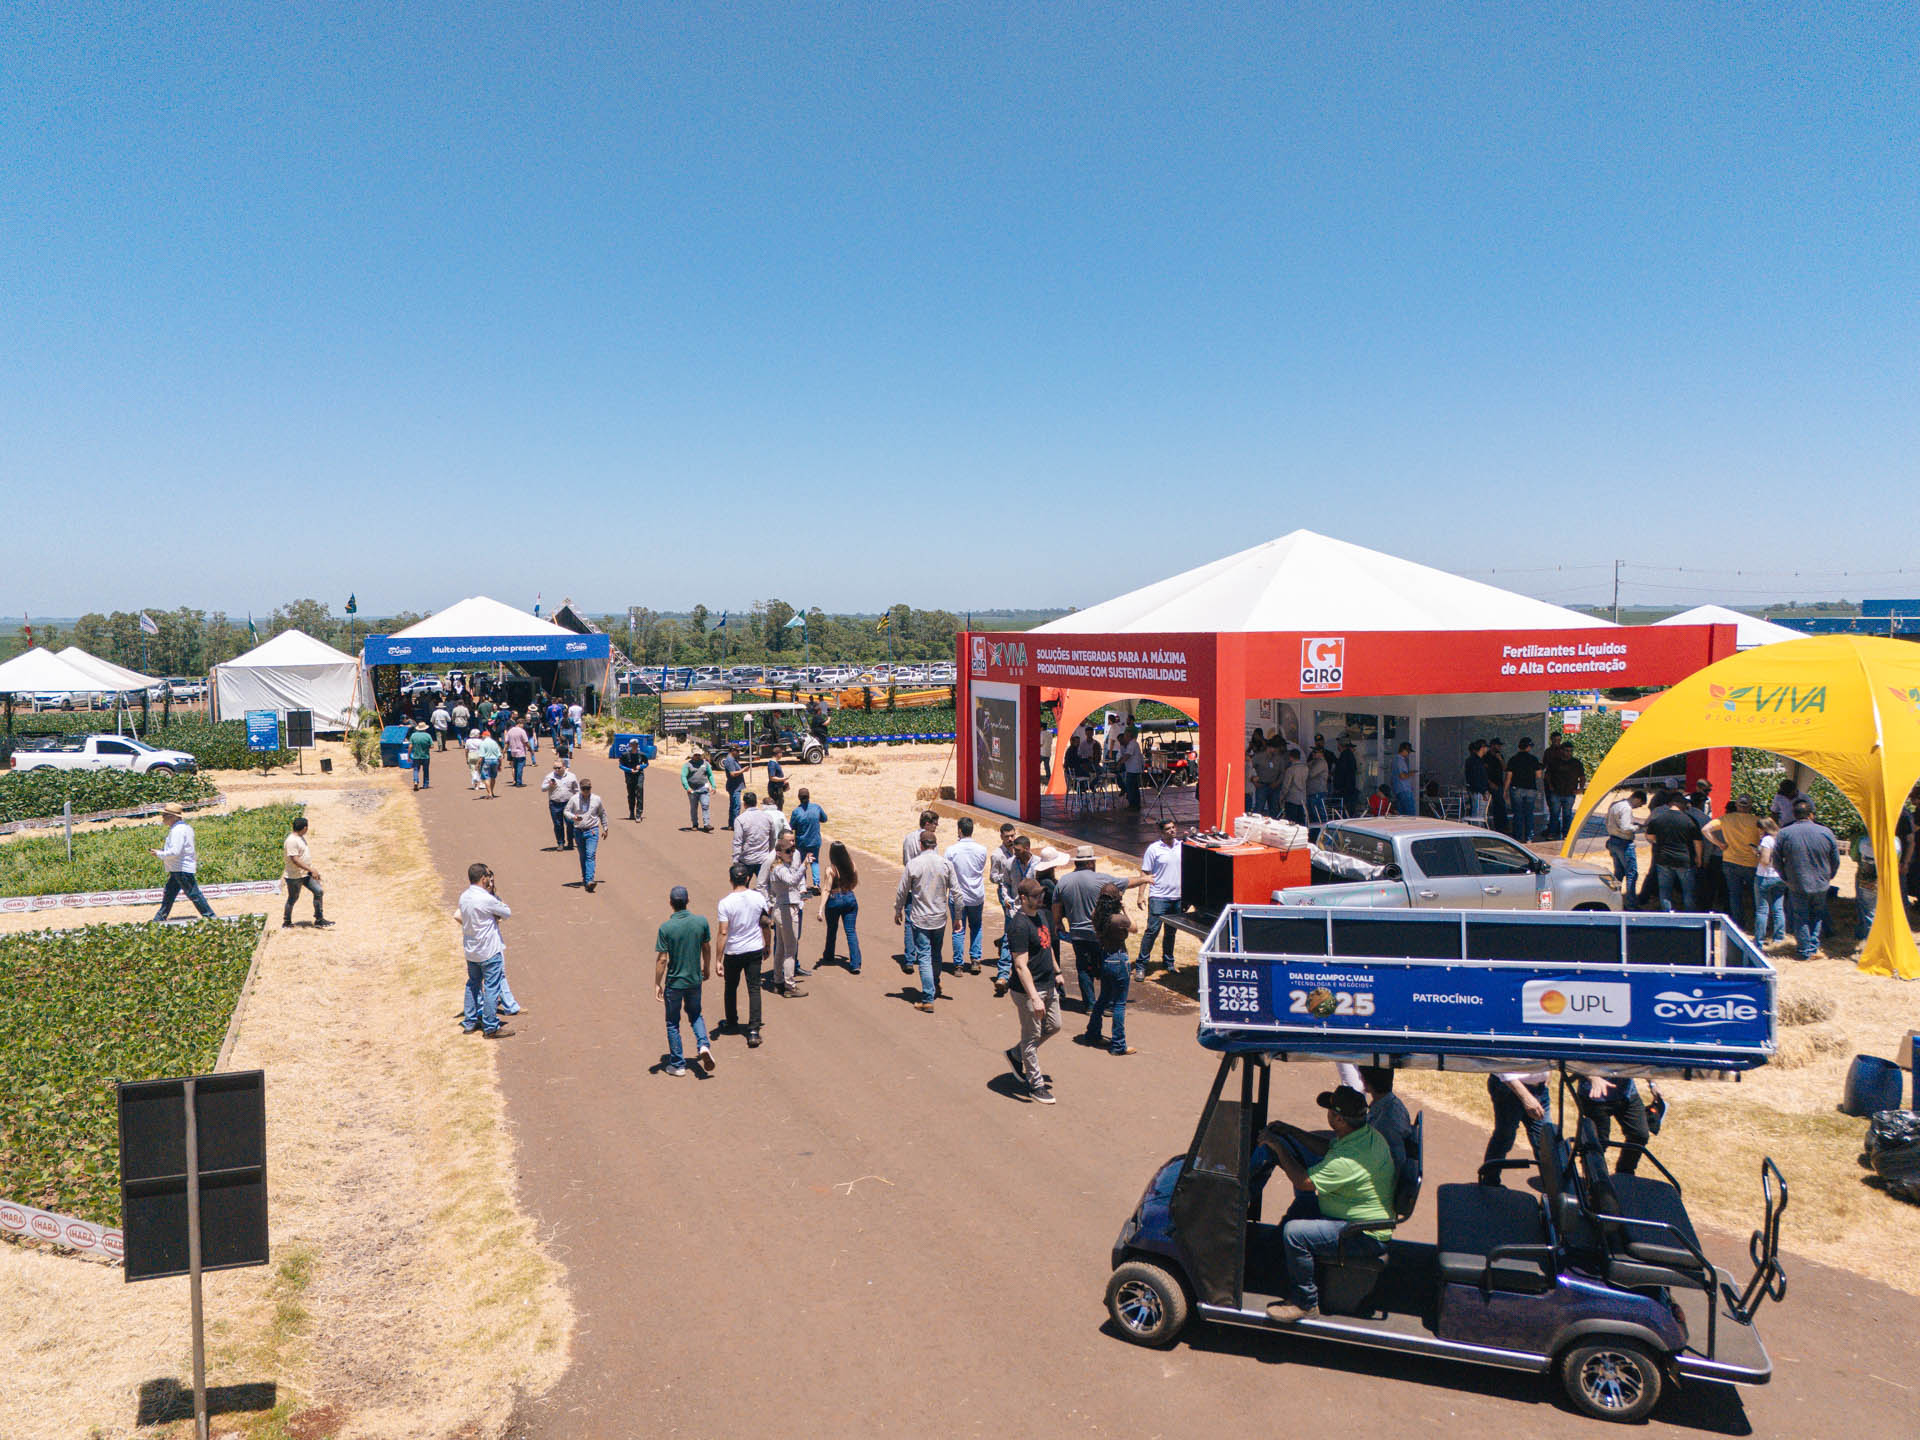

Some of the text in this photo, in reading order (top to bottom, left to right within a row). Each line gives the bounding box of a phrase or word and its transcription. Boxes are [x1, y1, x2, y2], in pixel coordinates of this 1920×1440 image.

[432, 644, 547, 654] Muito obrigado pela presença!
[1002, 642, 1028, 667] VIVA
[1036, 647, 1187, 664] SOLUÇÕES INTEGRADAS PARA A MÁXIMA
[1502, 642, 1627, 658] Fertilizantes Líquidos
[1037, 663, 1187, 681] PRODUTIVIDADE COM SUSTENTABILIDADE
[1501, 659, 1627, 675] de Alta Concentração
[1302, 669, 1342, 683] GIRO
[1756, 686, 1827, 712] VIVA
[1218, 969, 1258, 979] SAFRA
[1289, 972, 1303, 980] DIA
[1304, 973, 1315, 981] DE
[1219, 985, 1258, 999] 2025
[1412, 992, 1484, 1005] PATROCÍNIO:
[1219, 999, 1259, 1012] 2026
[1571, 995, 1613, 1013] UPL
[0, 1211, 23, 1224] IHARA
[34, 1219, 58, 1233] IHARA
[69, 1229, 93, 1243] IHARA
